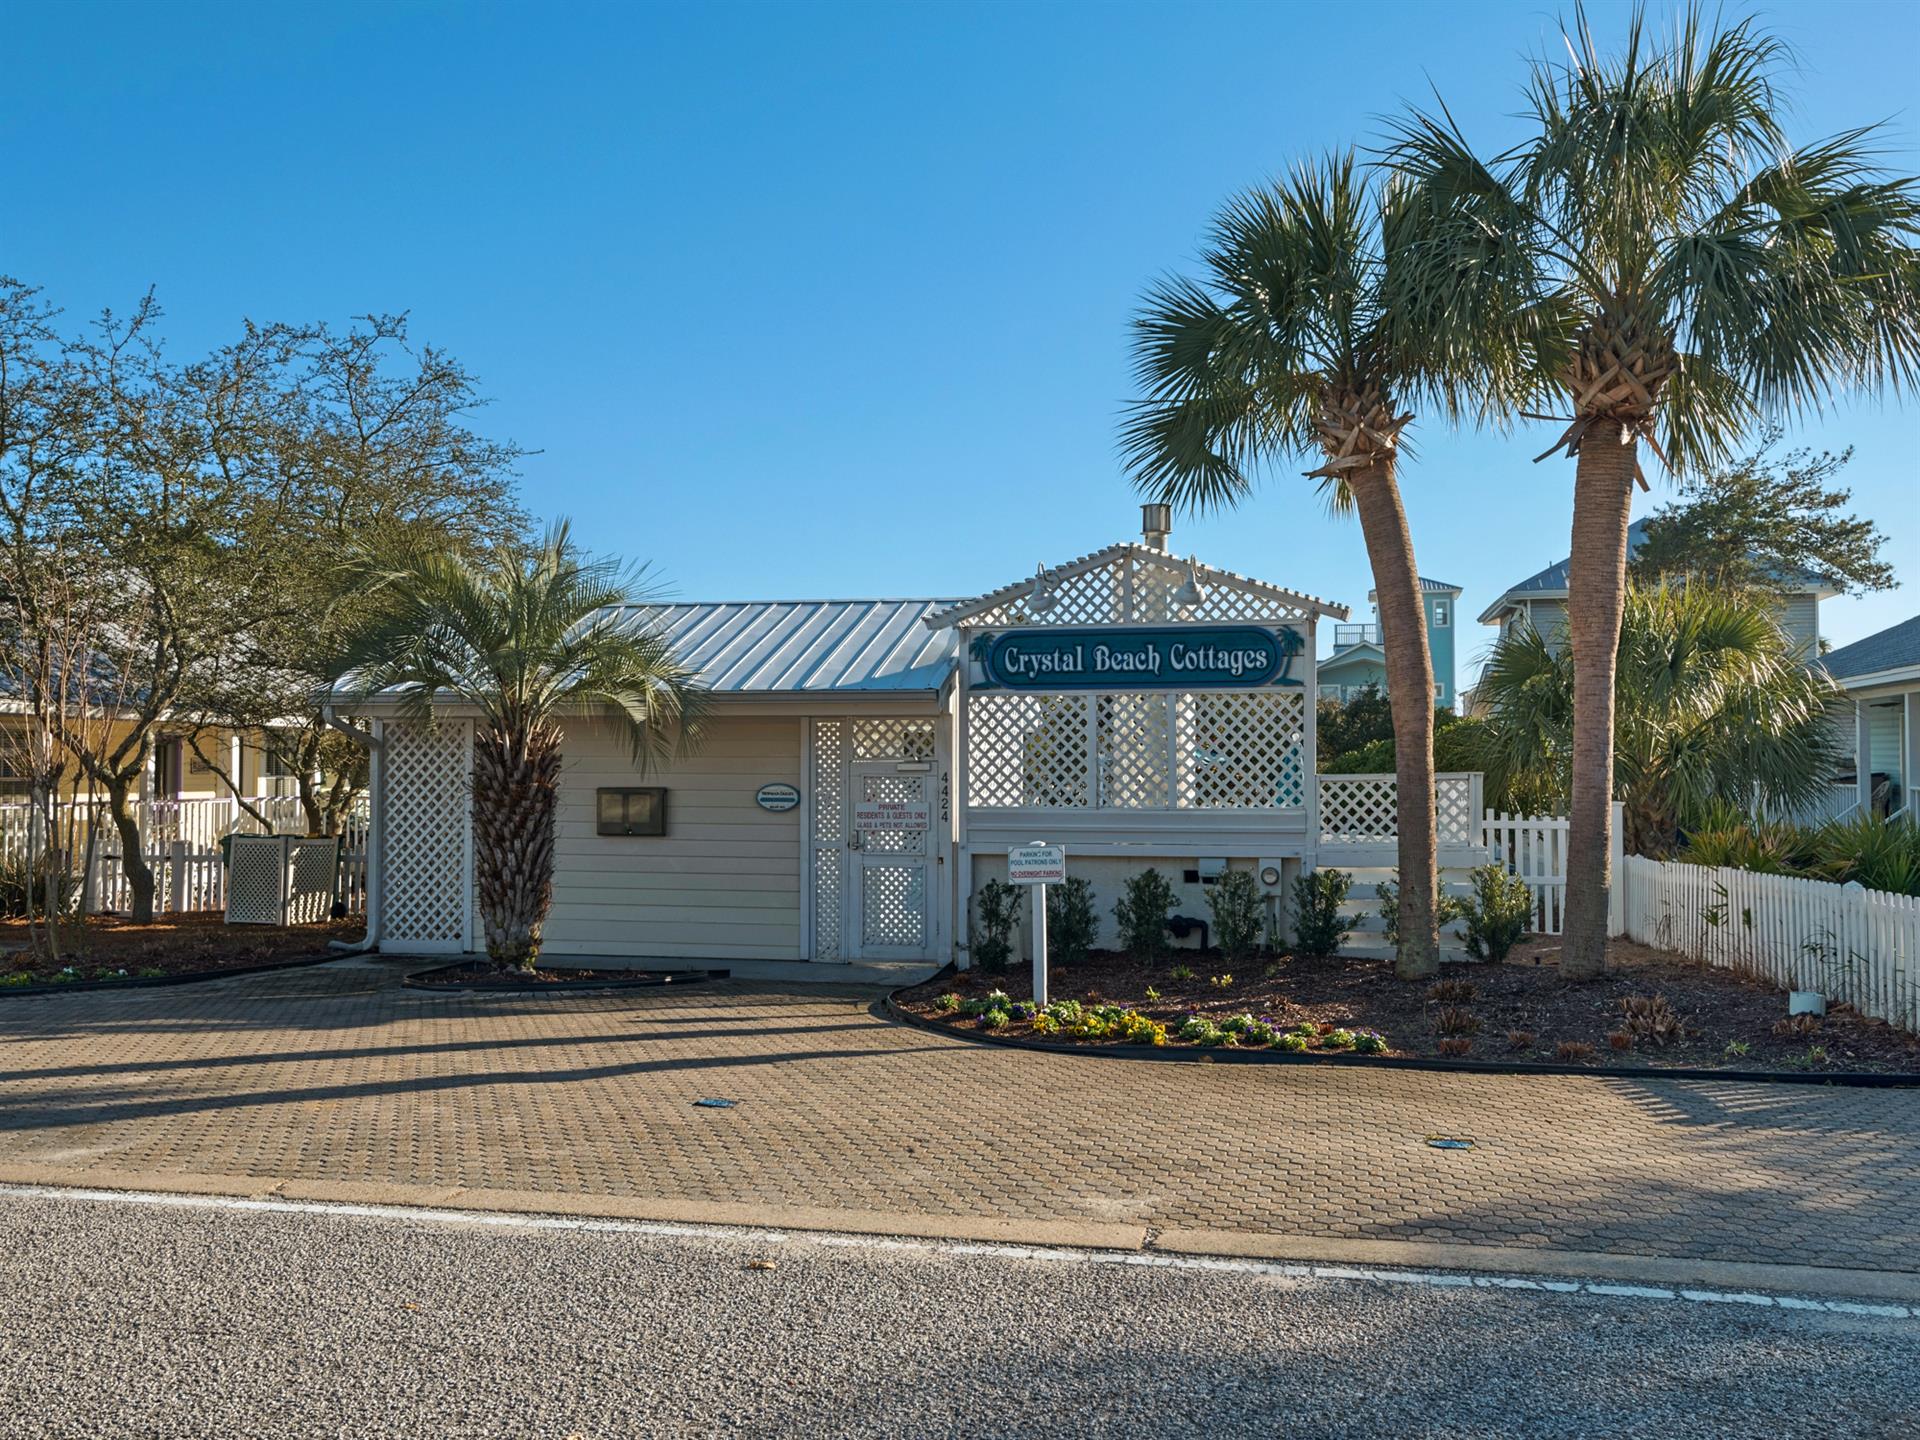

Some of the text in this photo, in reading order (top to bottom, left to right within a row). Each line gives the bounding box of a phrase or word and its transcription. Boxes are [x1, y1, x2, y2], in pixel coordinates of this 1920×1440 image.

[1004, 643, 1267, 678] Crystal Beach Cottages
[878, 803, 905, 811] PRIVATE
[941, 771, 949, 823] 4424
[856, 811, 885, 820] RESIDENTS
[892, 811, 913, 819] GUESTS
[914, 811, 928, 819] ONLY
